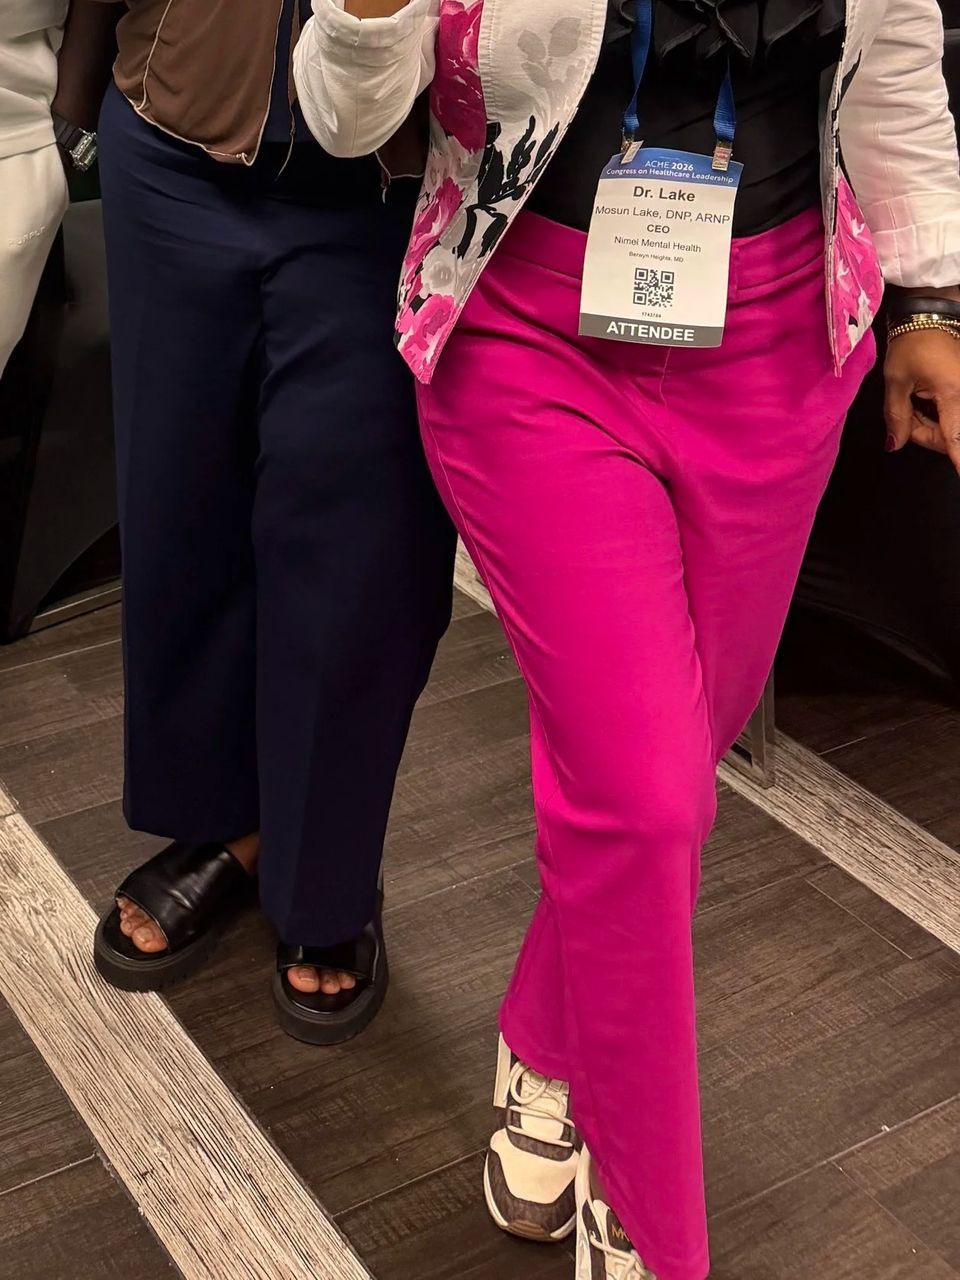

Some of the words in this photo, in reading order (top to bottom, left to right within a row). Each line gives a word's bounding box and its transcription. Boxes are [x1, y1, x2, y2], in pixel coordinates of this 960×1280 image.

[644, 160, 669, 168] ACHE
[671, 162, 694, 171] 2026
[606, 168, 637, 177] Congress
[649, 169, 690, 179] Healthcare
[691, 171, 734, 184] Leadership
[633, 186, 653, 199] Dr.
[659, 187, 696, 202] Lake
[595, 205, 630, 216] Mosun
[633, 207, 662, 220] Lake,
[666, 209, 692, 221] DNP,
[695, 212, 731, 225] ARNP
[646, 224, 670, 234] CEO
[641, 239, 670, 249] Mental
[673, 242, 701, 253] Health
[606, 320, 695, 341] ATTENDEE
